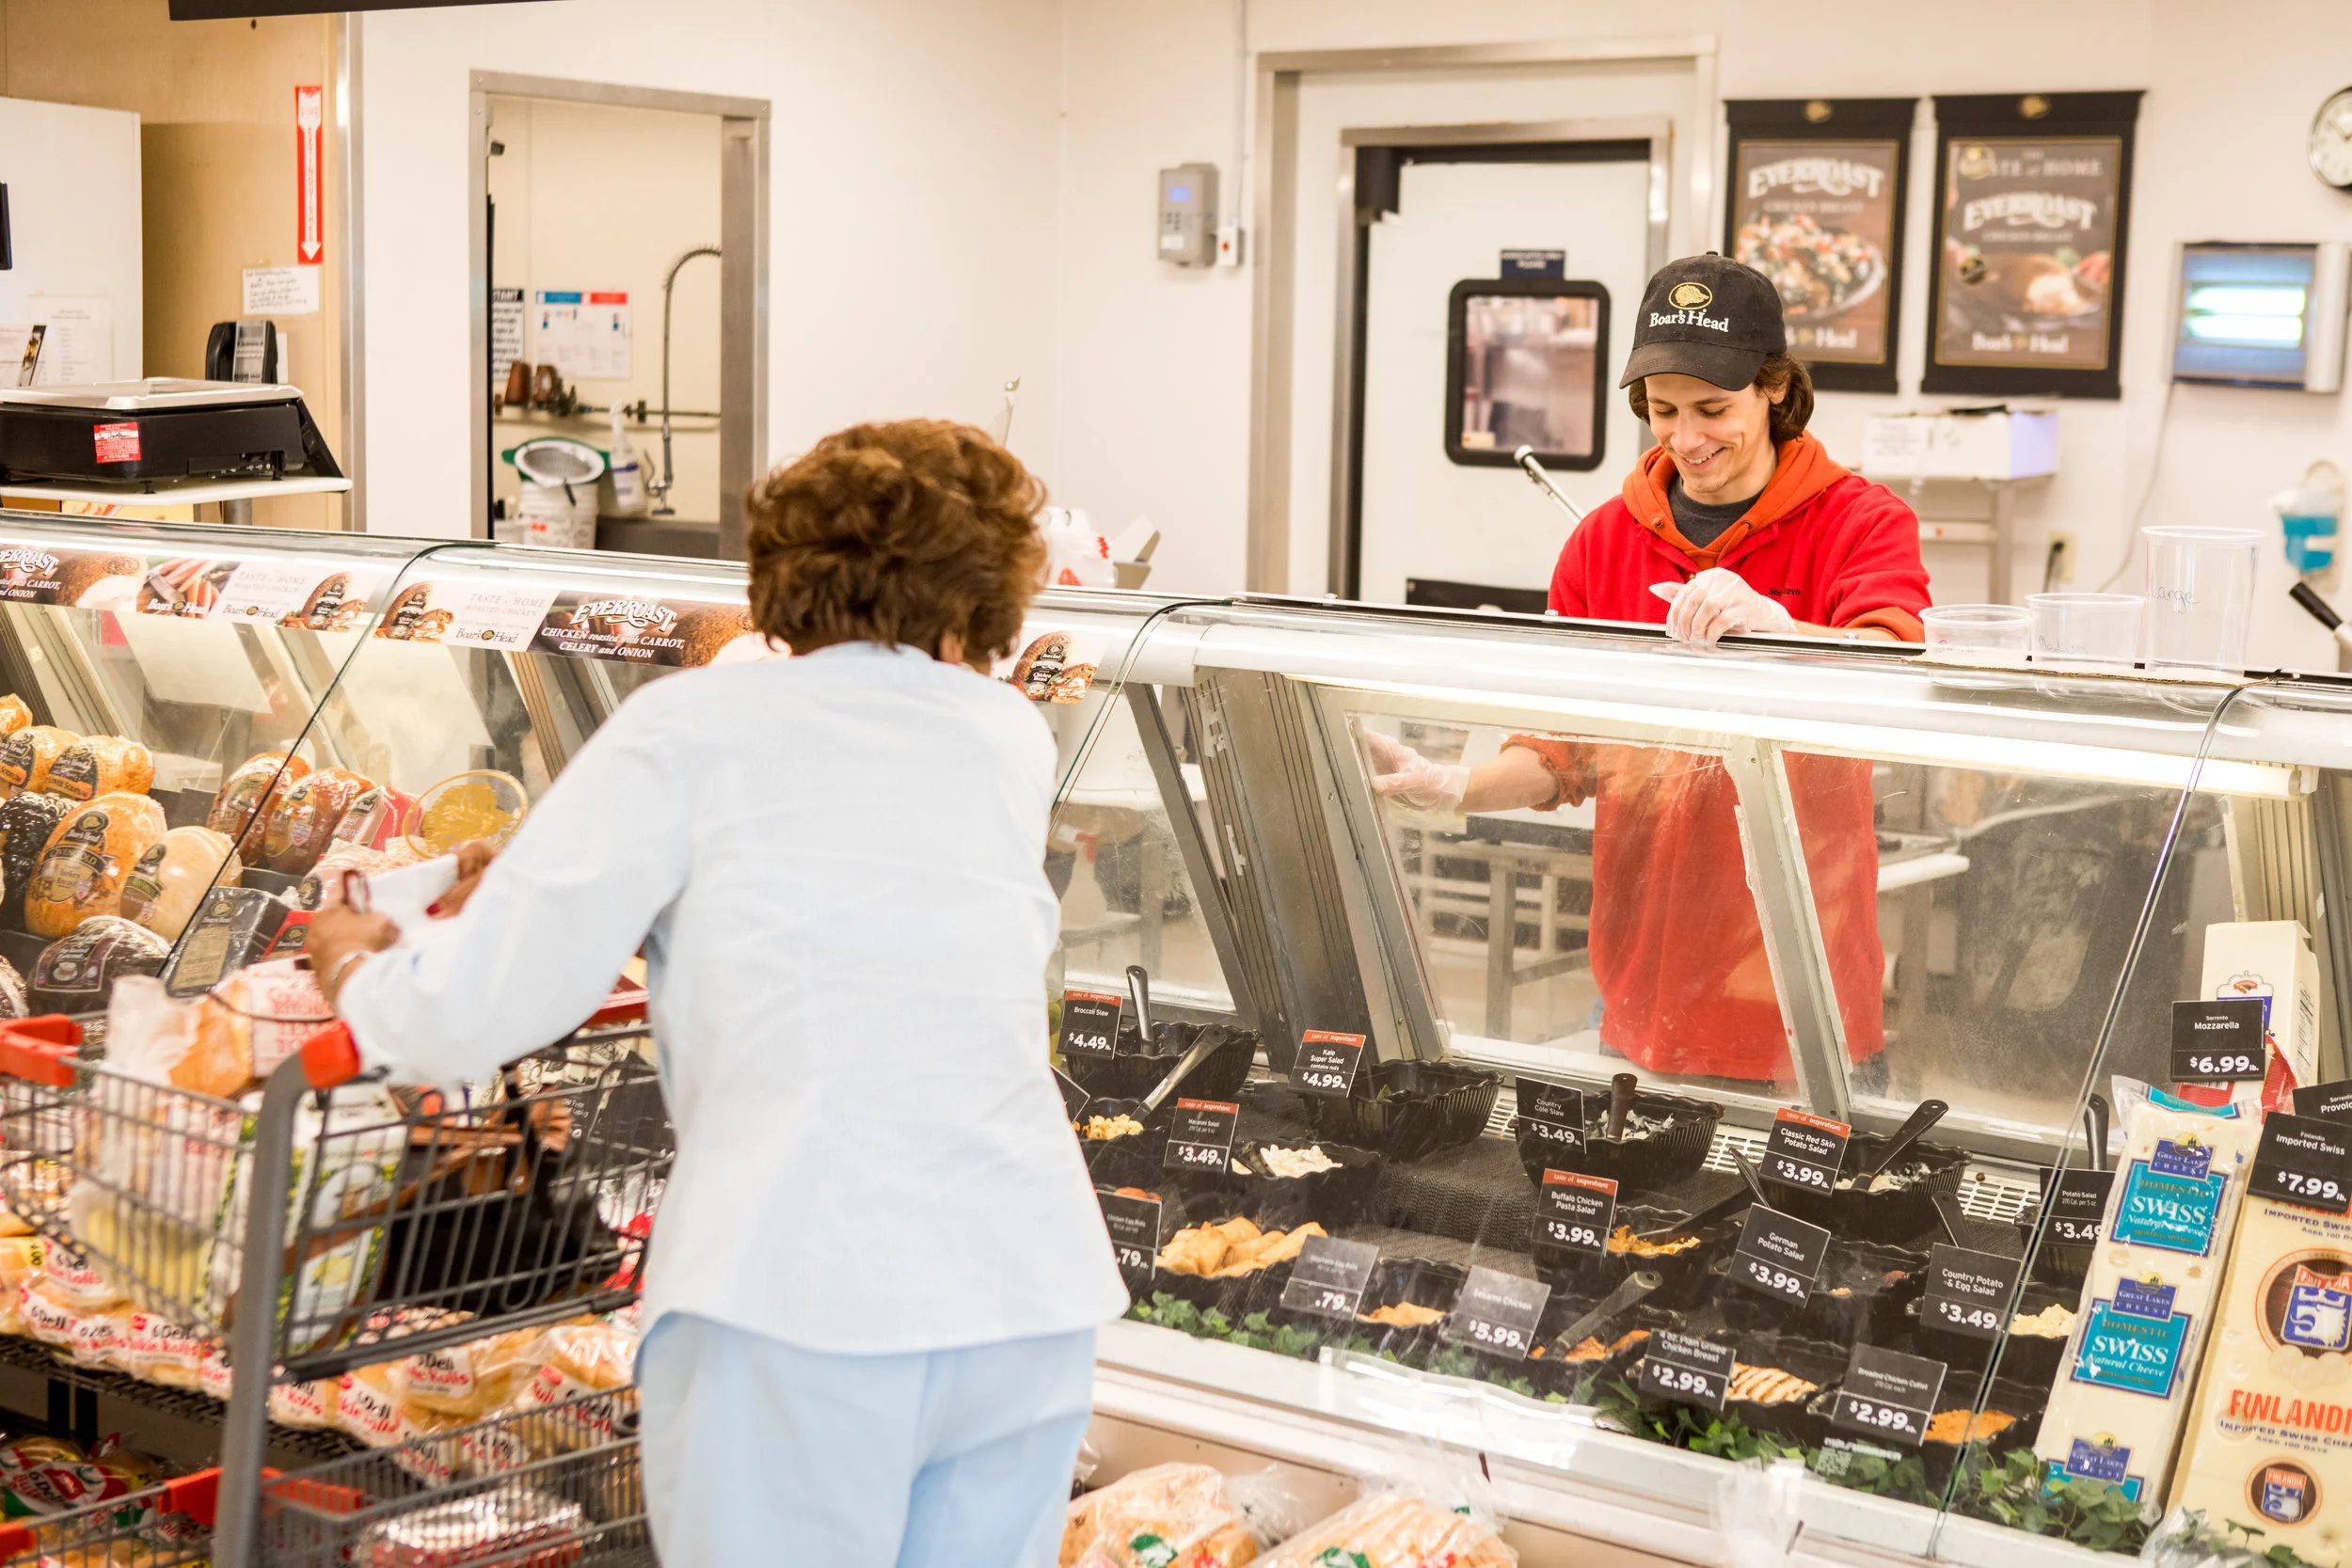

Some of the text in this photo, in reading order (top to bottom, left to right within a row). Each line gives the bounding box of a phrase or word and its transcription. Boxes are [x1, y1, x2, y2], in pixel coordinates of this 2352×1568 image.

[2042, 161, 2103, 177] HOME
[1747, 157, 1883, 199] EVERROAST
[1963, 191, 2097, 231] EVERROAST
[1649, 309, 1729, 332] Boar's Head
[8, 590, 37, 599] ONION
[570, 599, 677, 633] EVERROAST
[455, 627, 519, 643] Boar's Head
[541, 626, 589, 640] CHICKEN
[589, 632, 619, 642] roasted
[640, 636, 685, 650] CARROT,
[559, 641, 656, 658] CELERY and ONION
[1073, 1006, 1109, 1017] Broccoli Slaw
[2194, 1022, 2240, 1031] Mozzarella
[1310, 1054, 1345, 1065] Super Salad
[2189, 1055, 2250, 1073] $6.99
[1534, 1104, 1565, 1117] Cole Slaw
[1536, 1098, 1562, 1110] Country
[1188, 1118, 1208, 1127] Macaroni
[1780, 1128, 1836, 1149] Classic Red Skin
[2276, 1133, 2345, 1155] Imported Swiss
[2300, 1132, 2326, 1141] Finlandia
[1784, 1137, 1828, 1155] Potato Salad
[2153, 1162, 2204, 1175] CHEESE
[2278, 1171, 2339, 1199] $7.99
[1550, 1191, 1603, 1208] Buffalo Chicken
[2062, 1190, 2081, 1198] Potato
[1555, 1200, 1597, 1215] Pasta Salad
[2129, 1195, 2207, 1226] SWISS
[2265, 1209, 2352, 1231] IMPORTED SWIS
[1757, 1237, 1804, 1261] Potato Salad
[1769, 1232, 1799, 1249] German
[1942, 1268, 2004, 1289] Country Potato
[1947, 1279, 1995, 1296] & Egg Salad
[1314, 1291, 1345, 1310] .79
[2116, 1302, 2167, 1316] CHEESE
[2102, 1319, 2168, 1338] DOMESTIC
[1661, 1339, 1720, 1363] Chicken Breast
[2091, 1336, 2169, 1365] SWISS
[2128, 1362, 2166, 1377] Cheese
[1883, 1373, 1909, 1386] Chicken
[2280, 1429, 2318, 1444] SWISS
[2267, 1471, 2304, 1487] FINLANDIA
